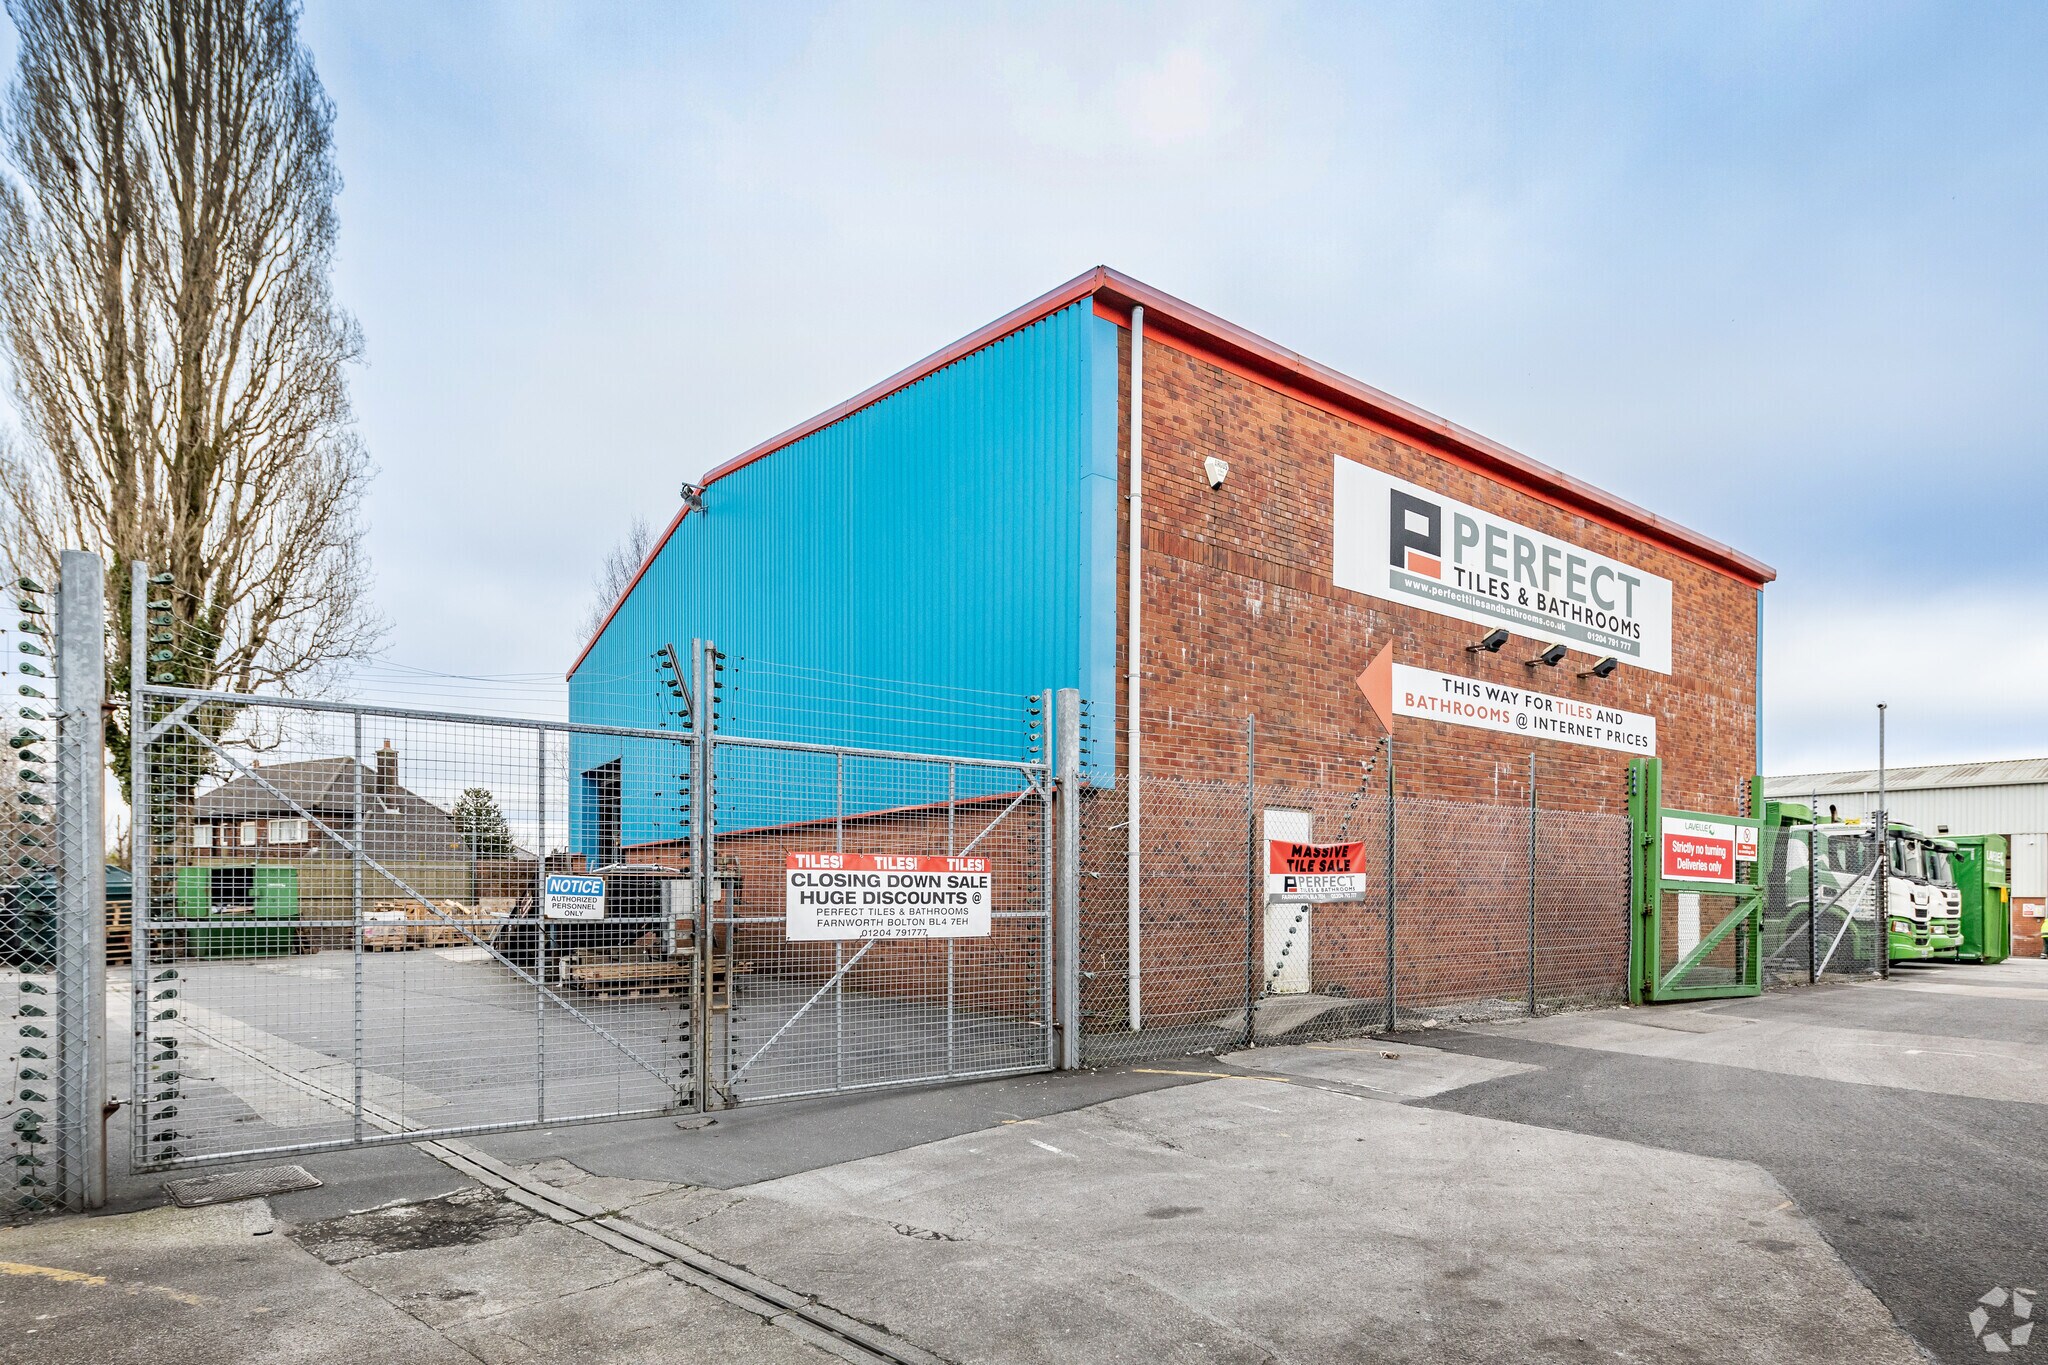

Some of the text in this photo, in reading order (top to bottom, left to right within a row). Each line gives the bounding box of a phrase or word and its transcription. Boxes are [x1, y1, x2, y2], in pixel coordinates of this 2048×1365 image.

[1454, 512, 1640, 617] PERFECT
[1454, 567, 1640, 639] TILES & BATHROOMS
[1405, 578, 1631, 650] www.perfecttilesandbathrooms.co.uk 01204 791 777
[1443, 679, 1623, 725] THIS WAY FOR TILES AND
[1406, 693, 1647, 747] BATHROOMS @ INTERNET PRICES
[1685, 822, 1708, 832] LAVELLE
[1292, 845, 1348, 858] MASSIVE
[1672, 840, 1694, 856] Strictly
[1696, 845, 1704, 854] no
[1705, 845, 1726, 859] turning
[796, 855, 843, 868] TILES!
[874, 857, 917, 870] TILES!
[947, 858, 984, 871] TILES!
[1287, 859, 1350, 872] TILE SALE
[1677, 858, 1722, 874] Deliveries only
[550, 880, 601, 893] NOTICE
[791, 873, 987, 888] CLOSING DOWN SALE
[1299, 876, 1355, 887] PERFECT
[801, 891, 981, 904] HUGE DISCOUNTS @
[817, 908, 864, 916] PERFECT
[868, 908, 895, 916] TILES
[817, 919, 883, 927] FARNWORTH
